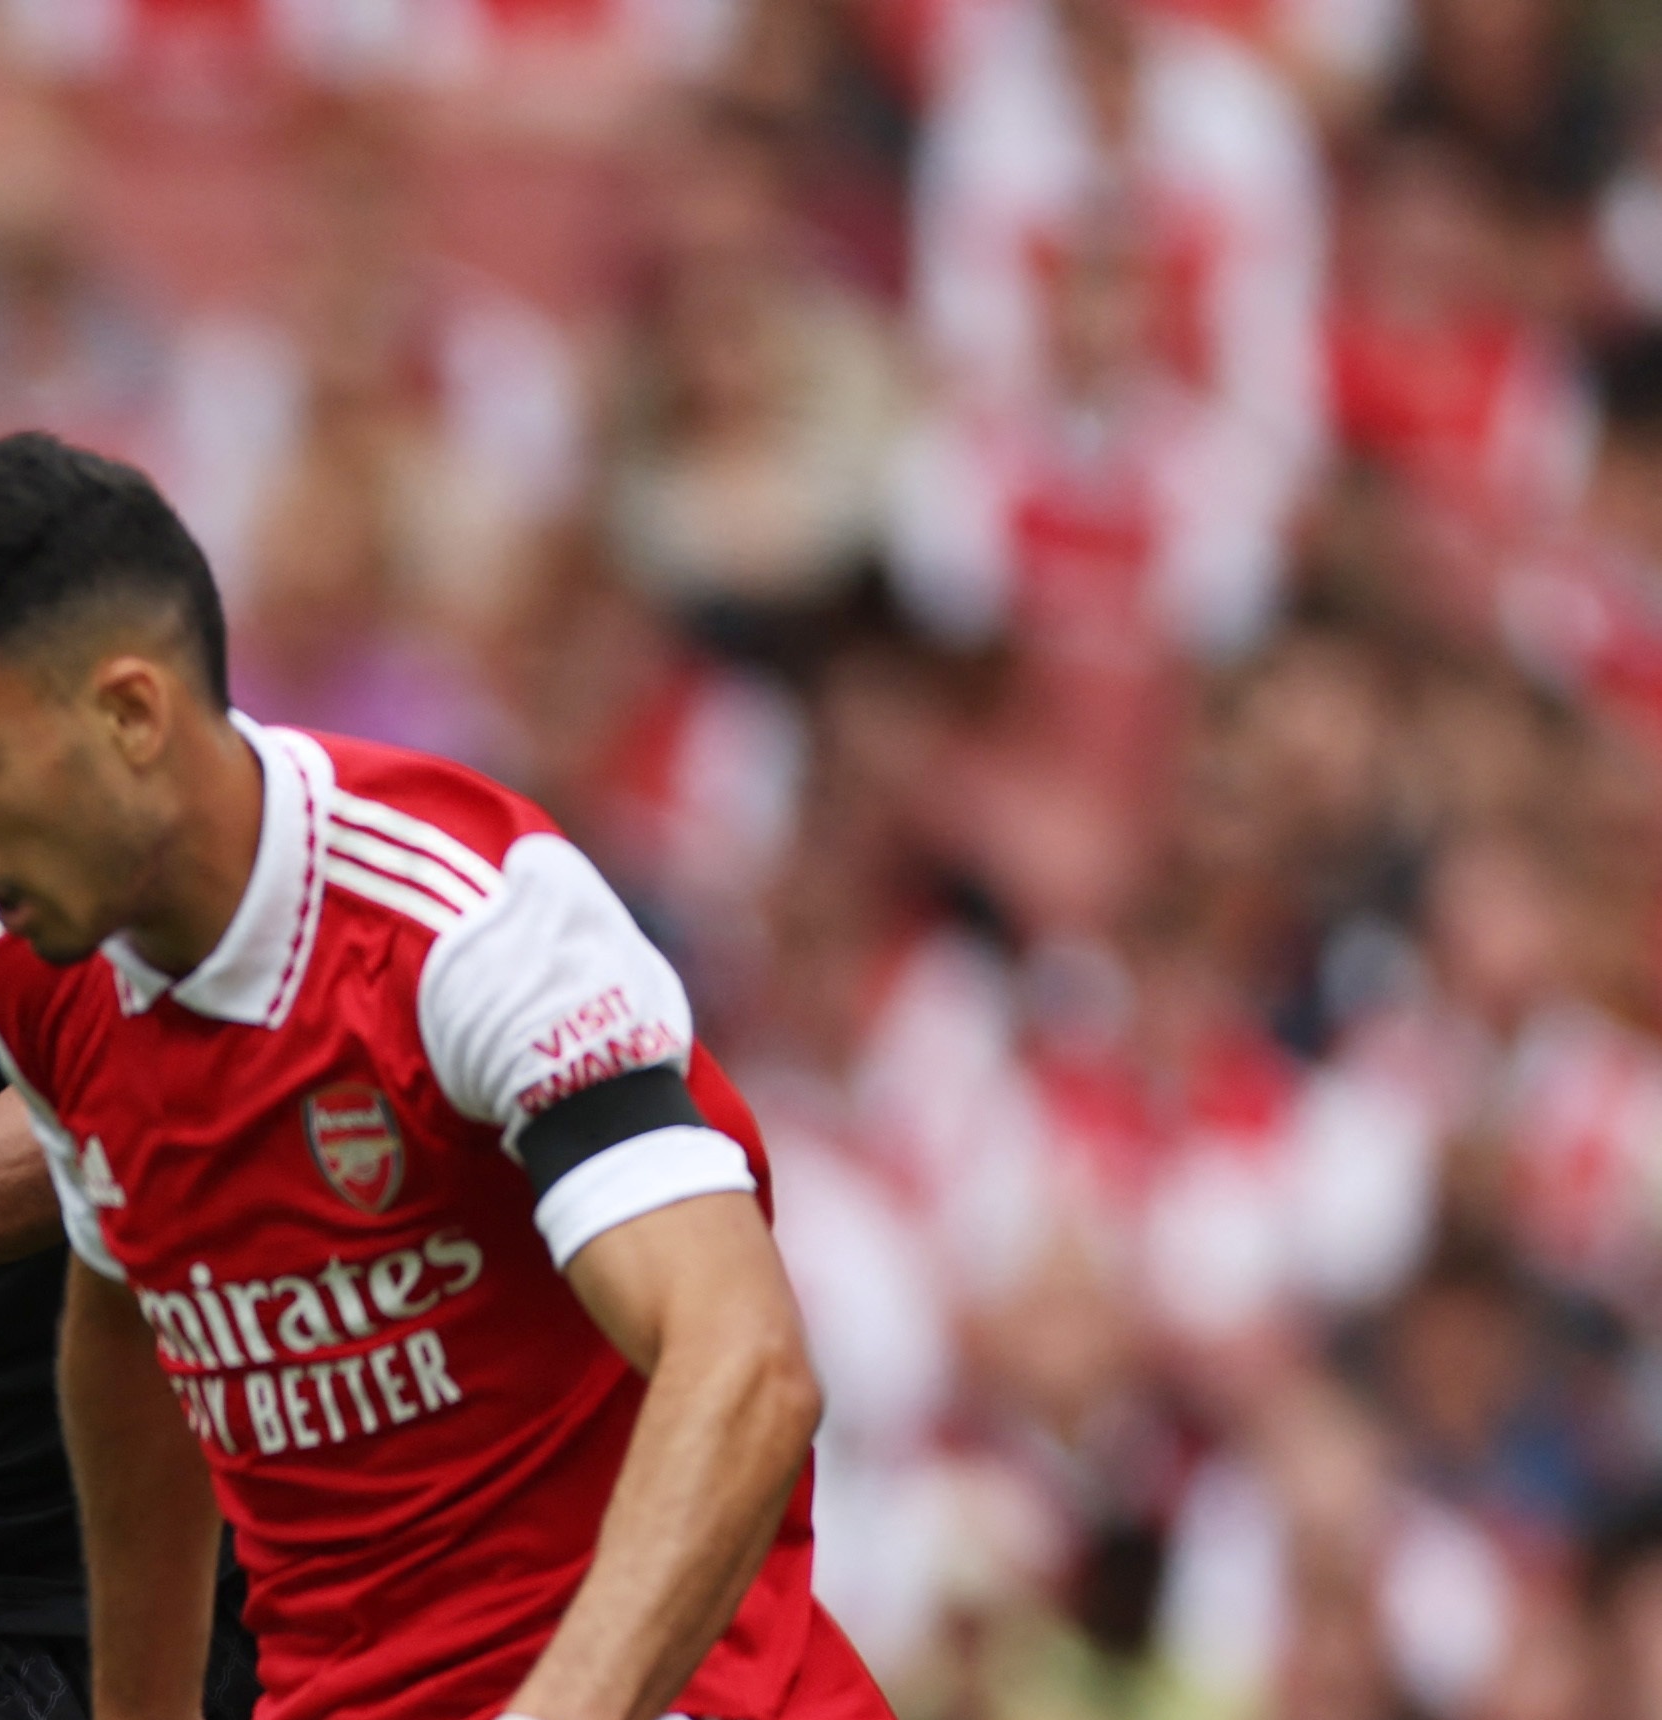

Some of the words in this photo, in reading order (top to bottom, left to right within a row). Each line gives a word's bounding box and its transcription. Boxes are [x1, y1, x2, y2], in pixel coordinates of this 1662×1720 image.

[532, 986, 631, 1059] VISIT
[136, 1226, 482, 1369] mirates
[244, 1328, 462, 1455] BETTER
